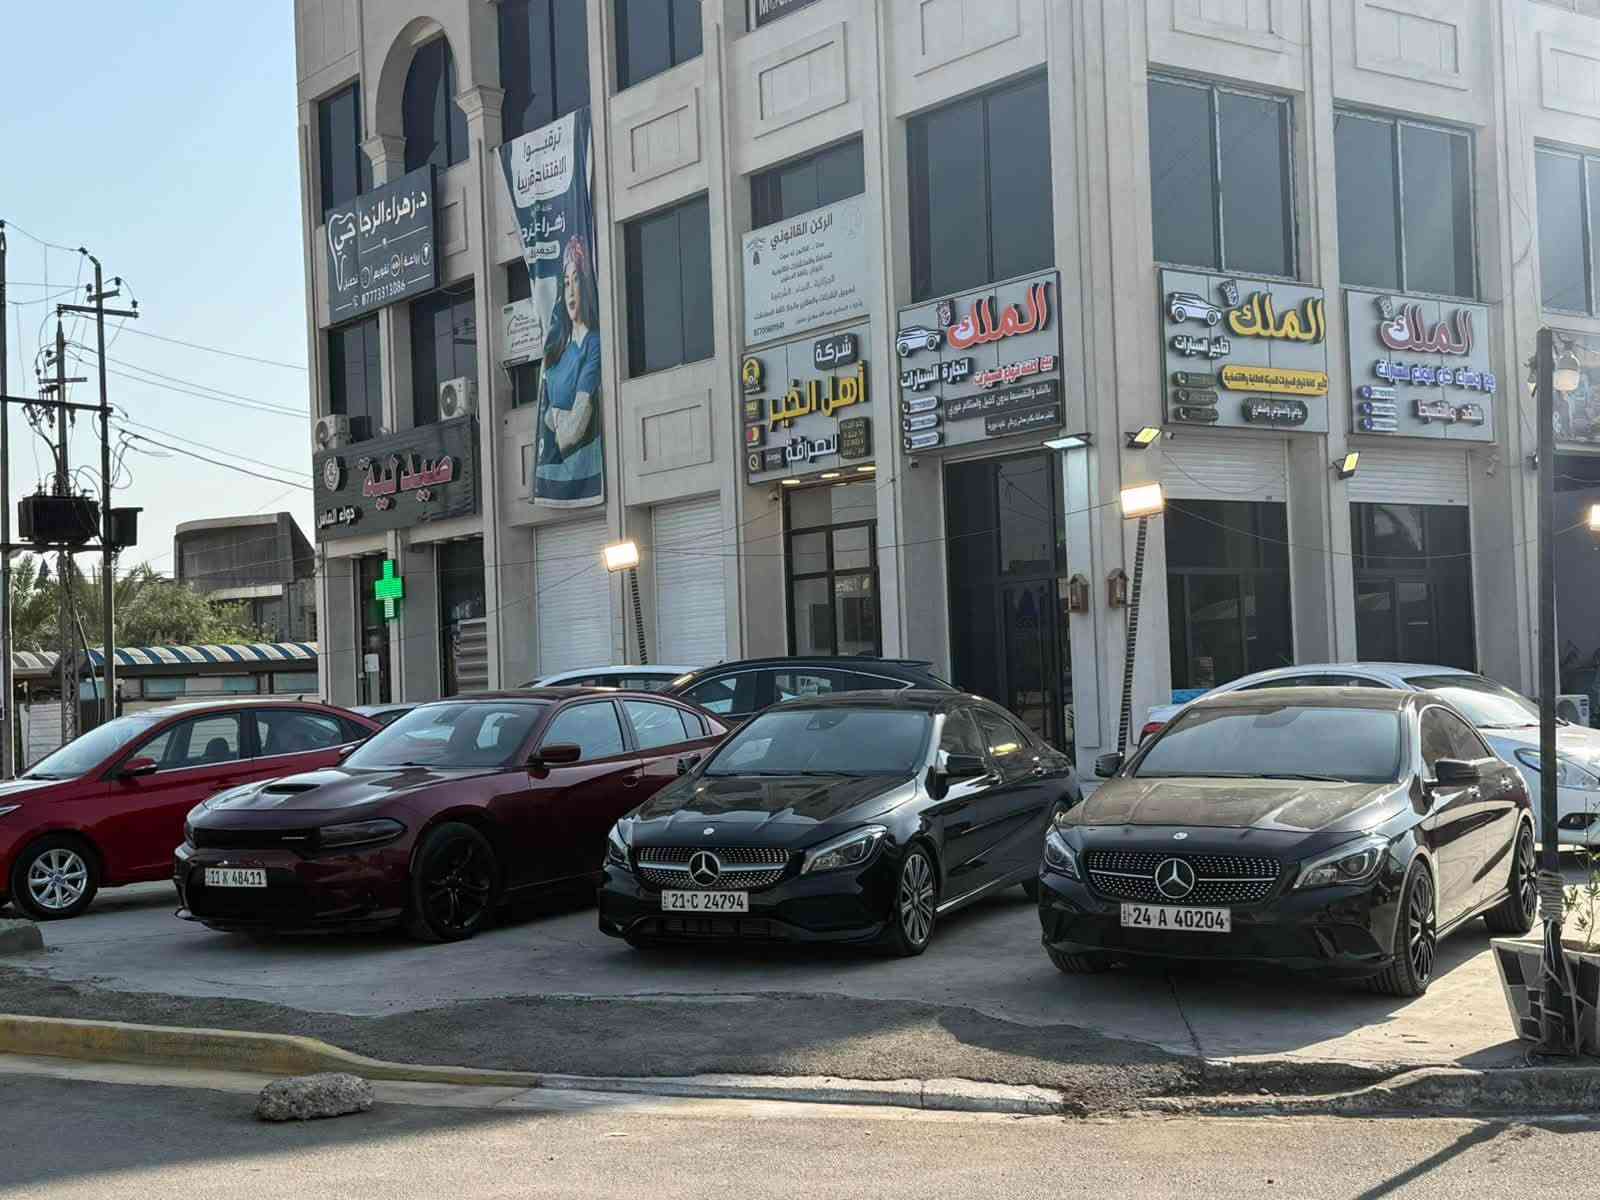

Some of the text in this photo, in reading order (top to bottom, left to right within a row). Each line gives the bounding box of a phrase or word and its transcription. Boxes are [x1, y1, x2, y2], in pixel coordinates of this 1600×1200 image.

[947, 283, 1048, 351] الملك
[1229, 292, 1326, 342] الملك
[1380, 303, 1473, 355] الملك
[815, 334, 853, 363] شركة
[1174, 335, 1209, 355] السيارات
[901, 358, 969, 391] لتجارة السيارات
[768, 359, 865, 432] أهل الخير
[358, 451, 454, 511] صيدلية
[703, 894, 744, 910] 24794
[1132, 907, 1152, 926] 24
[1158, 908, 1168, 927] A
[1174, 909, 1225, 929] 40204
